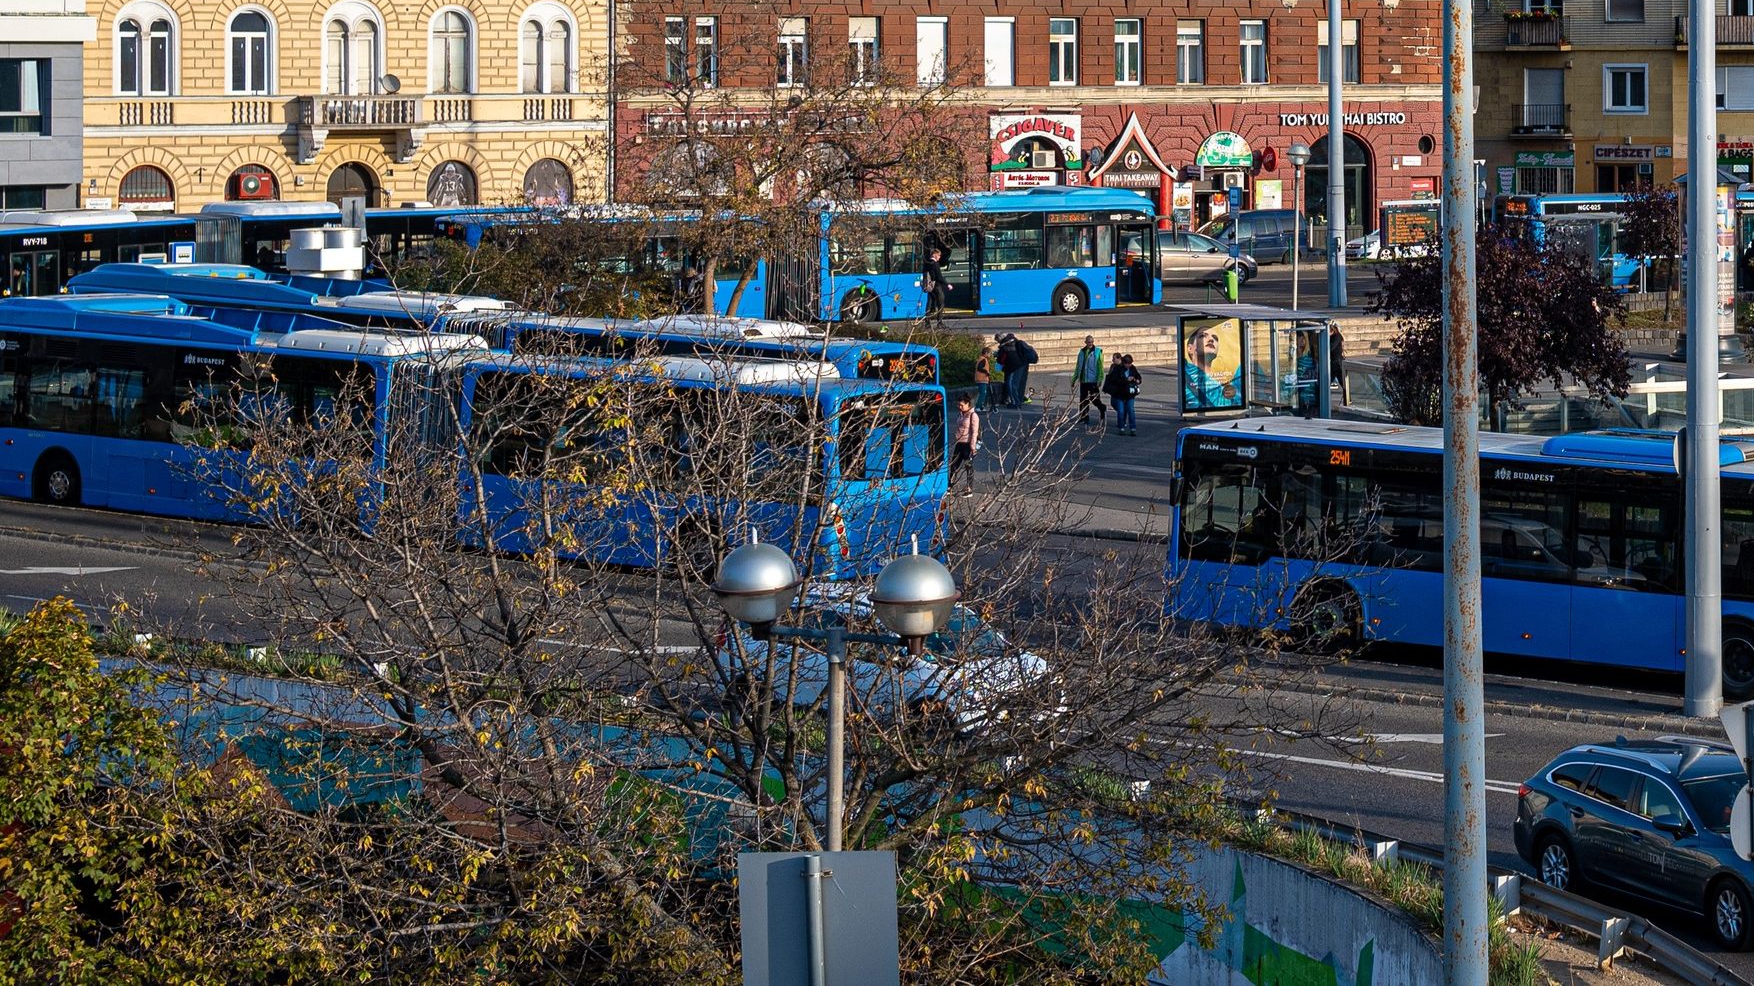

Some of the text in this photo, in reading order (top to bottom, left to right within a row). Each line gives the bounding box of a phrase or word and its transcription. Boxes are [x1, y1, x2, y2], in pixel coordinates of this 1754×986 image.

[1281, 111, 1406, 126] TOM YU HAI BISTRO
[1596, 146, 1652, 158] CIPÉSZET
[1728, 148, 1754, 158] BAGS
[1105, 174, 1159, 182] THAI TAKEAWAY
[445, 181, 456, 192] 13
[23, 237, 48, 246] RVY-718
[197, 356, 225, 365] BUDAPEST
[1330, 449, 1350, 466] 254M
[1513, 471, 1555, 482] BUDAPEST
